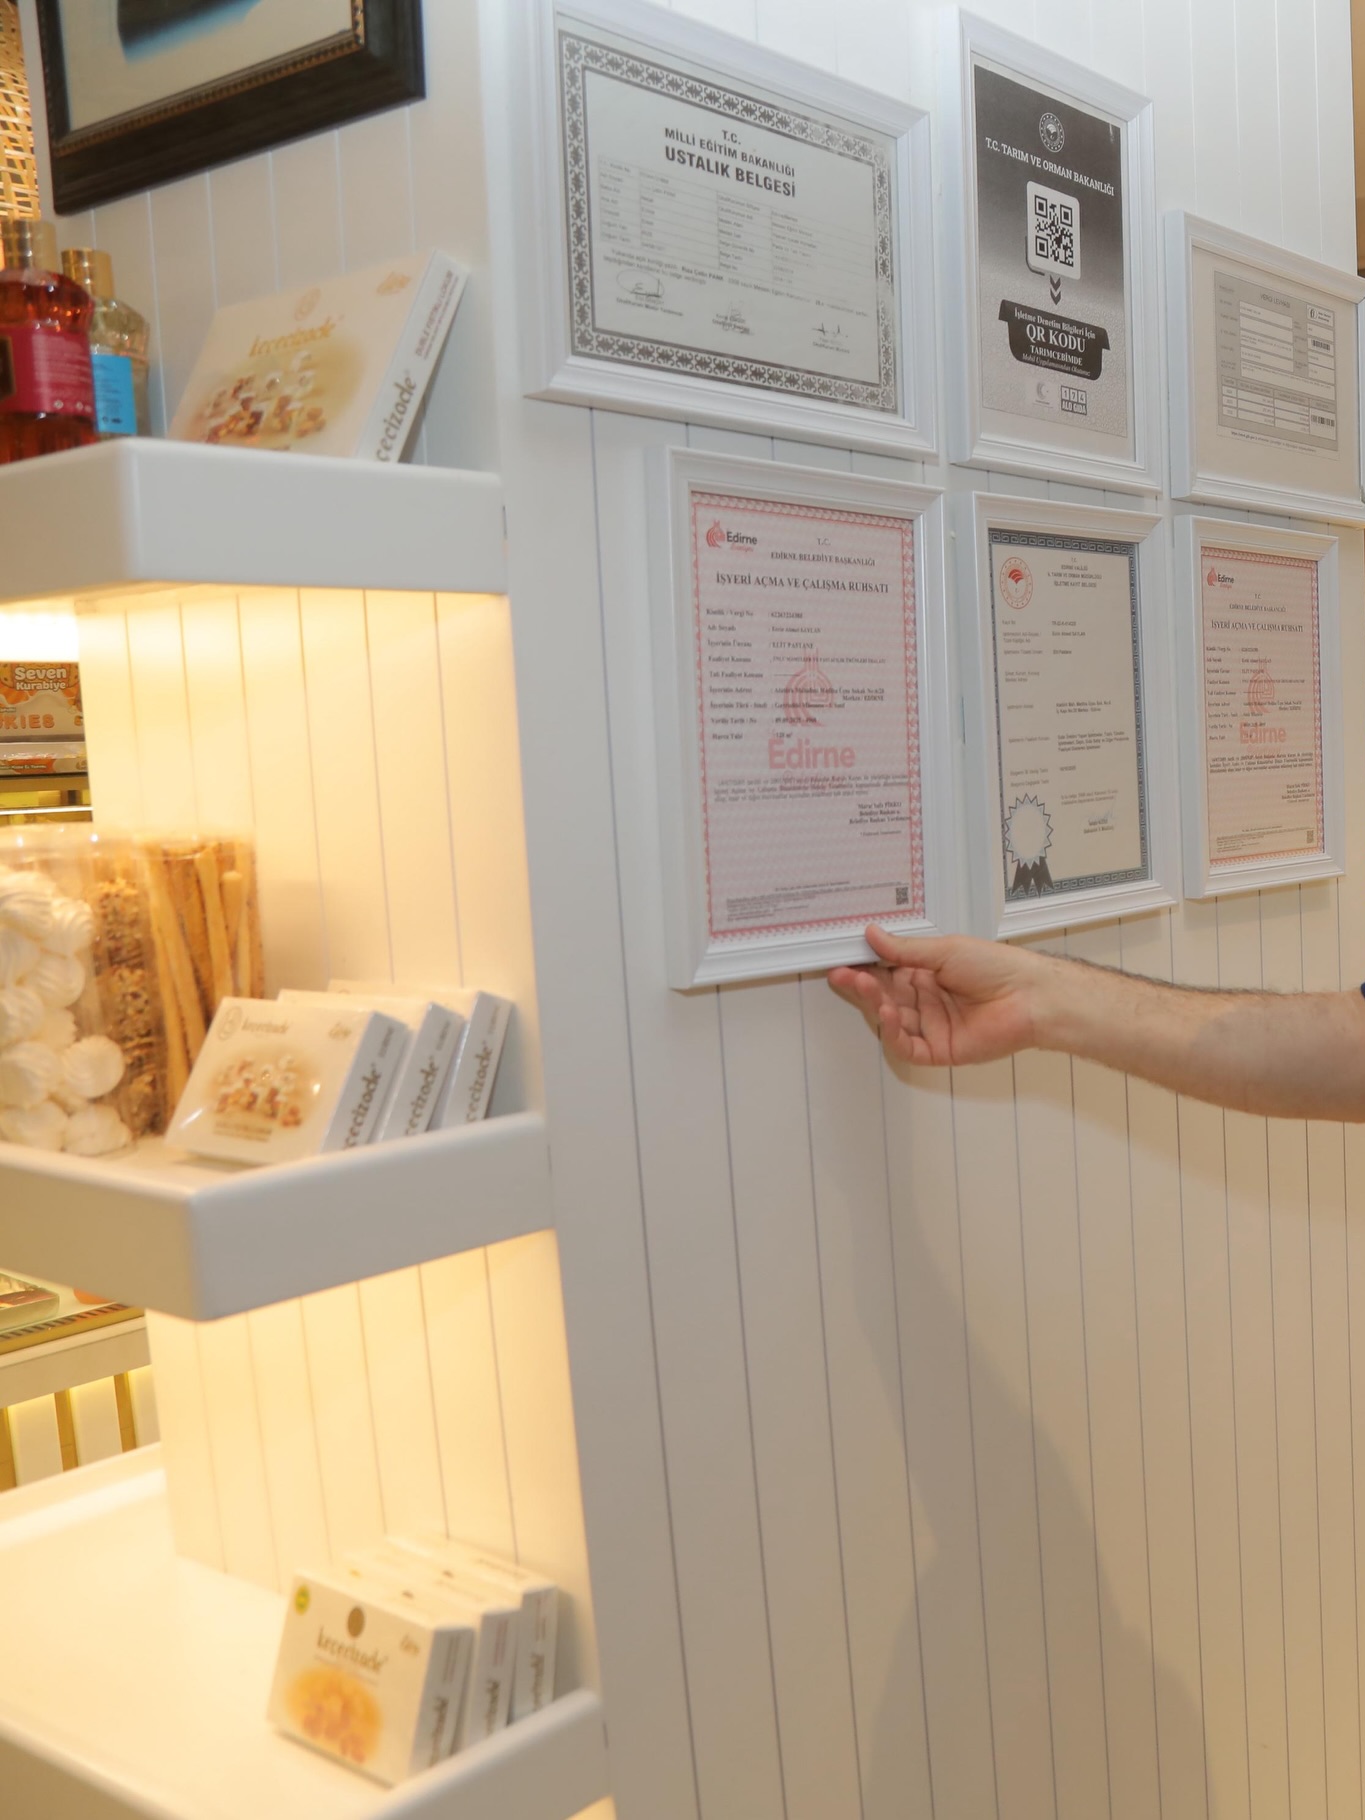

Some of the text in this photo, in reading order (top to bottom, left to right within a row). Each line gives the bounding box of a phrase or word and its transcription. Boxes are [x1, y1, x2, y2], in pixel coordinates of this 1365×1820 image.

[721, 129, 741, 145] T.C.
[665, 127, 796, 178] MİLLİ EĞİTİM BAKANLIĞI
[665, 146, 796, 198] USTALIK BELGESİ
[985, 137, 1115, 197] T.C. TARIM VE ORMAN BAKANLIĞI
[1026, 323, 1087, 353] QR KODU
[726, 530, 758, 546] Edirne
[716, 570, 889, 594] İŞYERİ AÇMA VE ÇALIŞMA RUHSATI
[14, 667, 67, 681] Seven
[16, 681, 66, 691] Kurabiye
[1239, 721, 1287, 745] Edirne
[768, 738, 856, 770] Edirne
